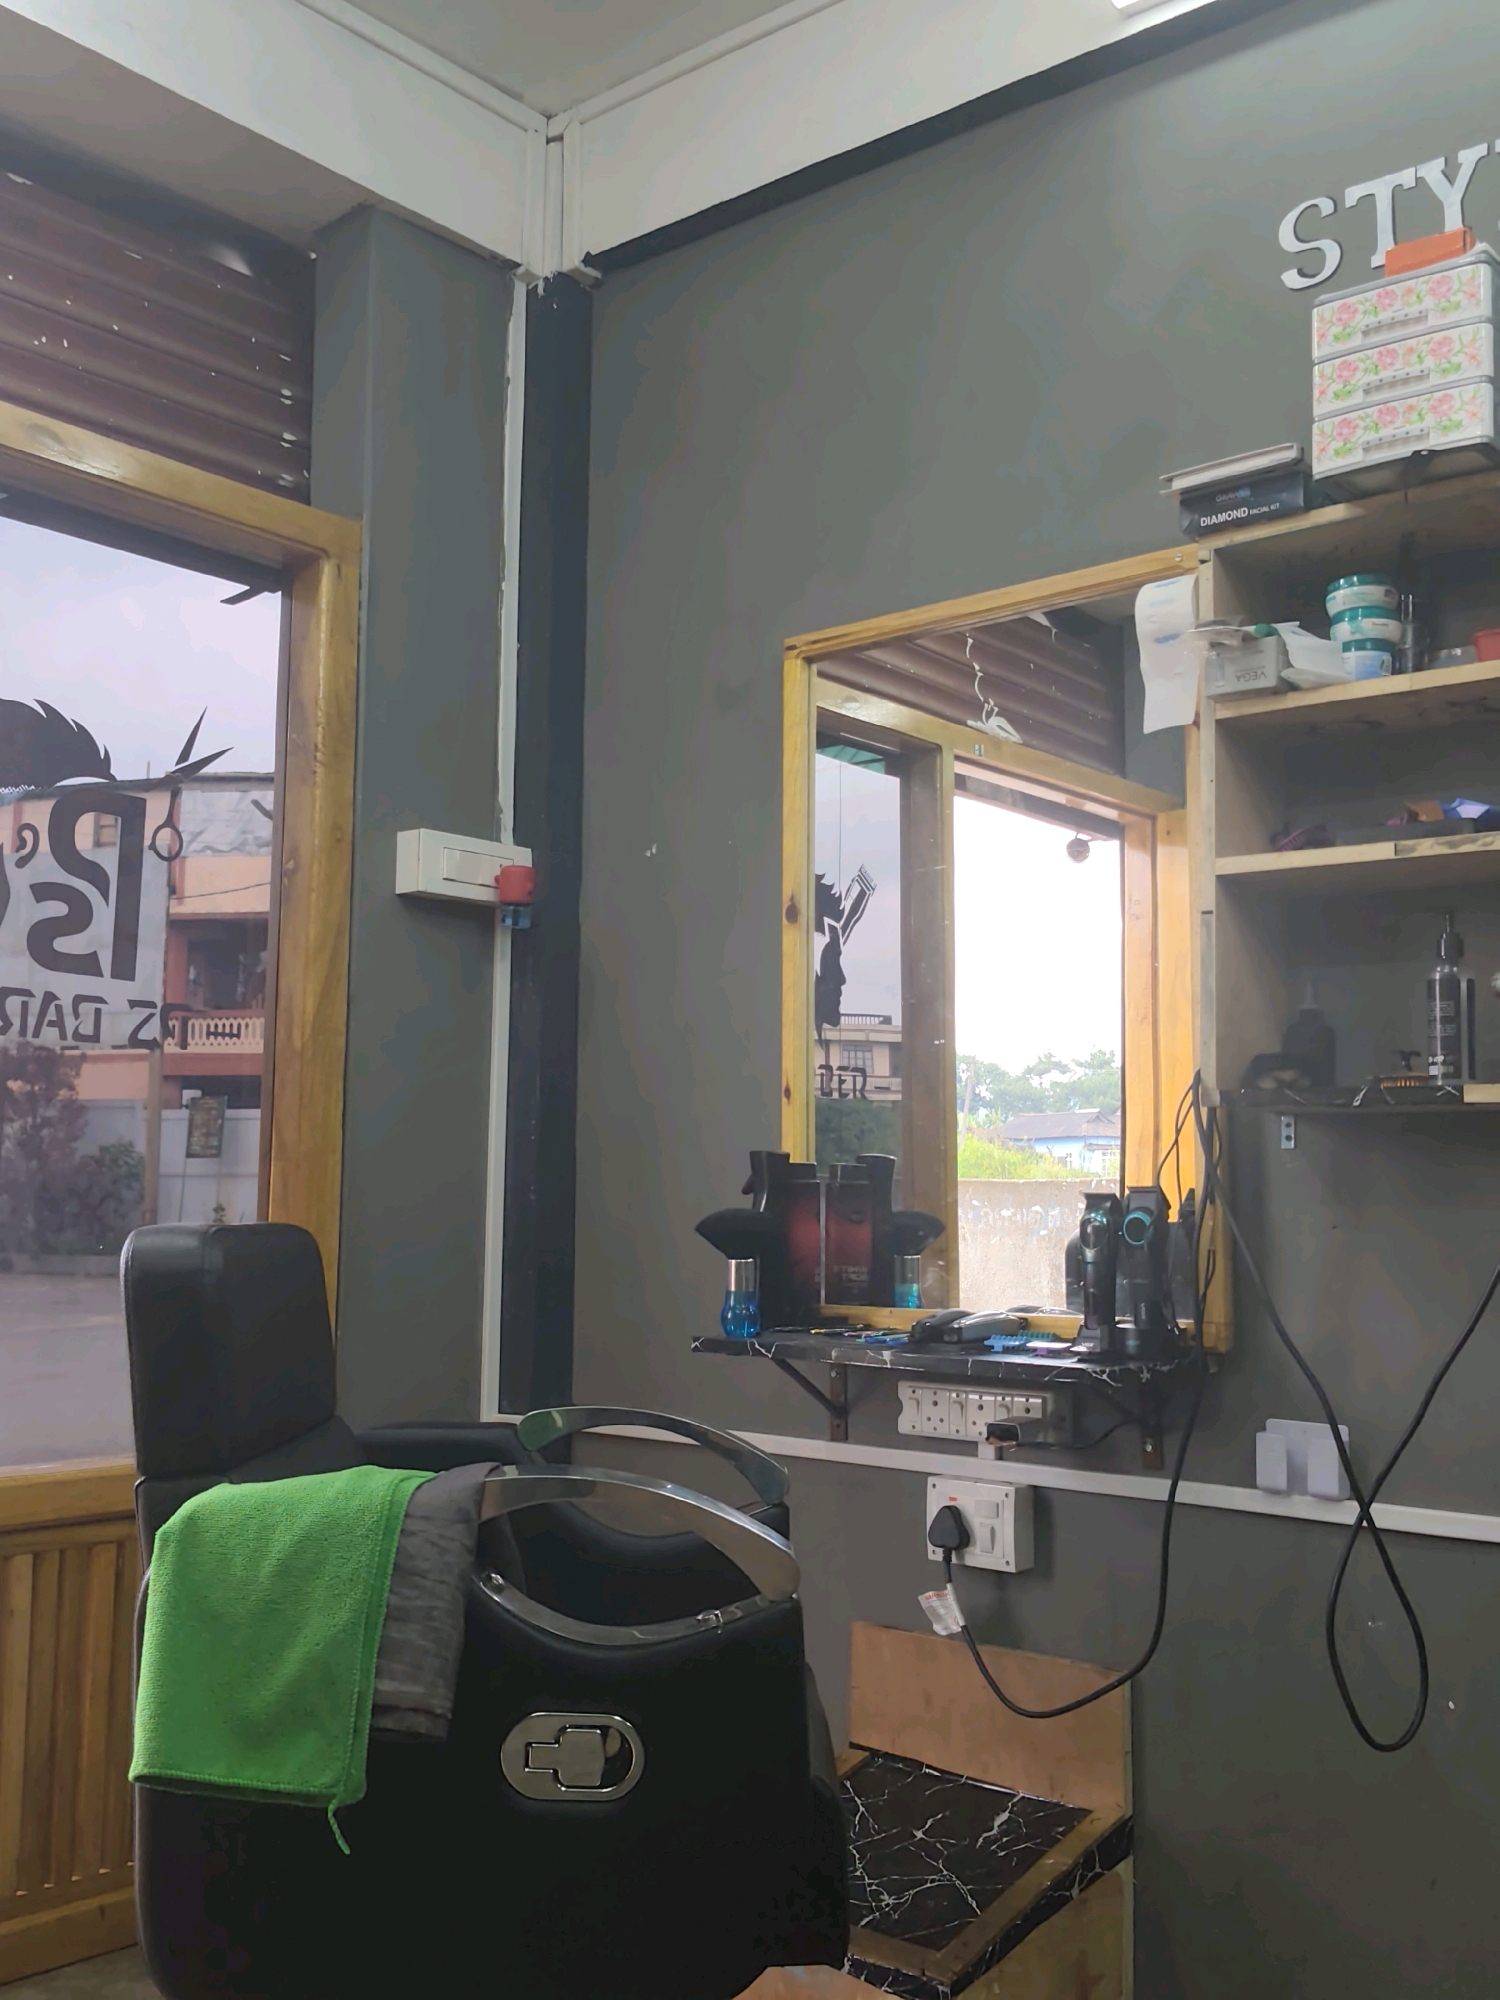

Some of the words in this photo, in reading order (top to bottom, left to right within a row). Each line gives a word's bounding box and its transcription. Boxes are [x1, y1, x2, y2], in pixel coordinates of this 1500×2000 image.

[1279, 139, 1500, 290] STY
[1200, 507, 1249, 526] DIAMOND
[1249, 506, 1270, 516] FACIAL
[1270, 502, 1280, 511] KIT
[1235, 670, 1267, 682] VEGA
